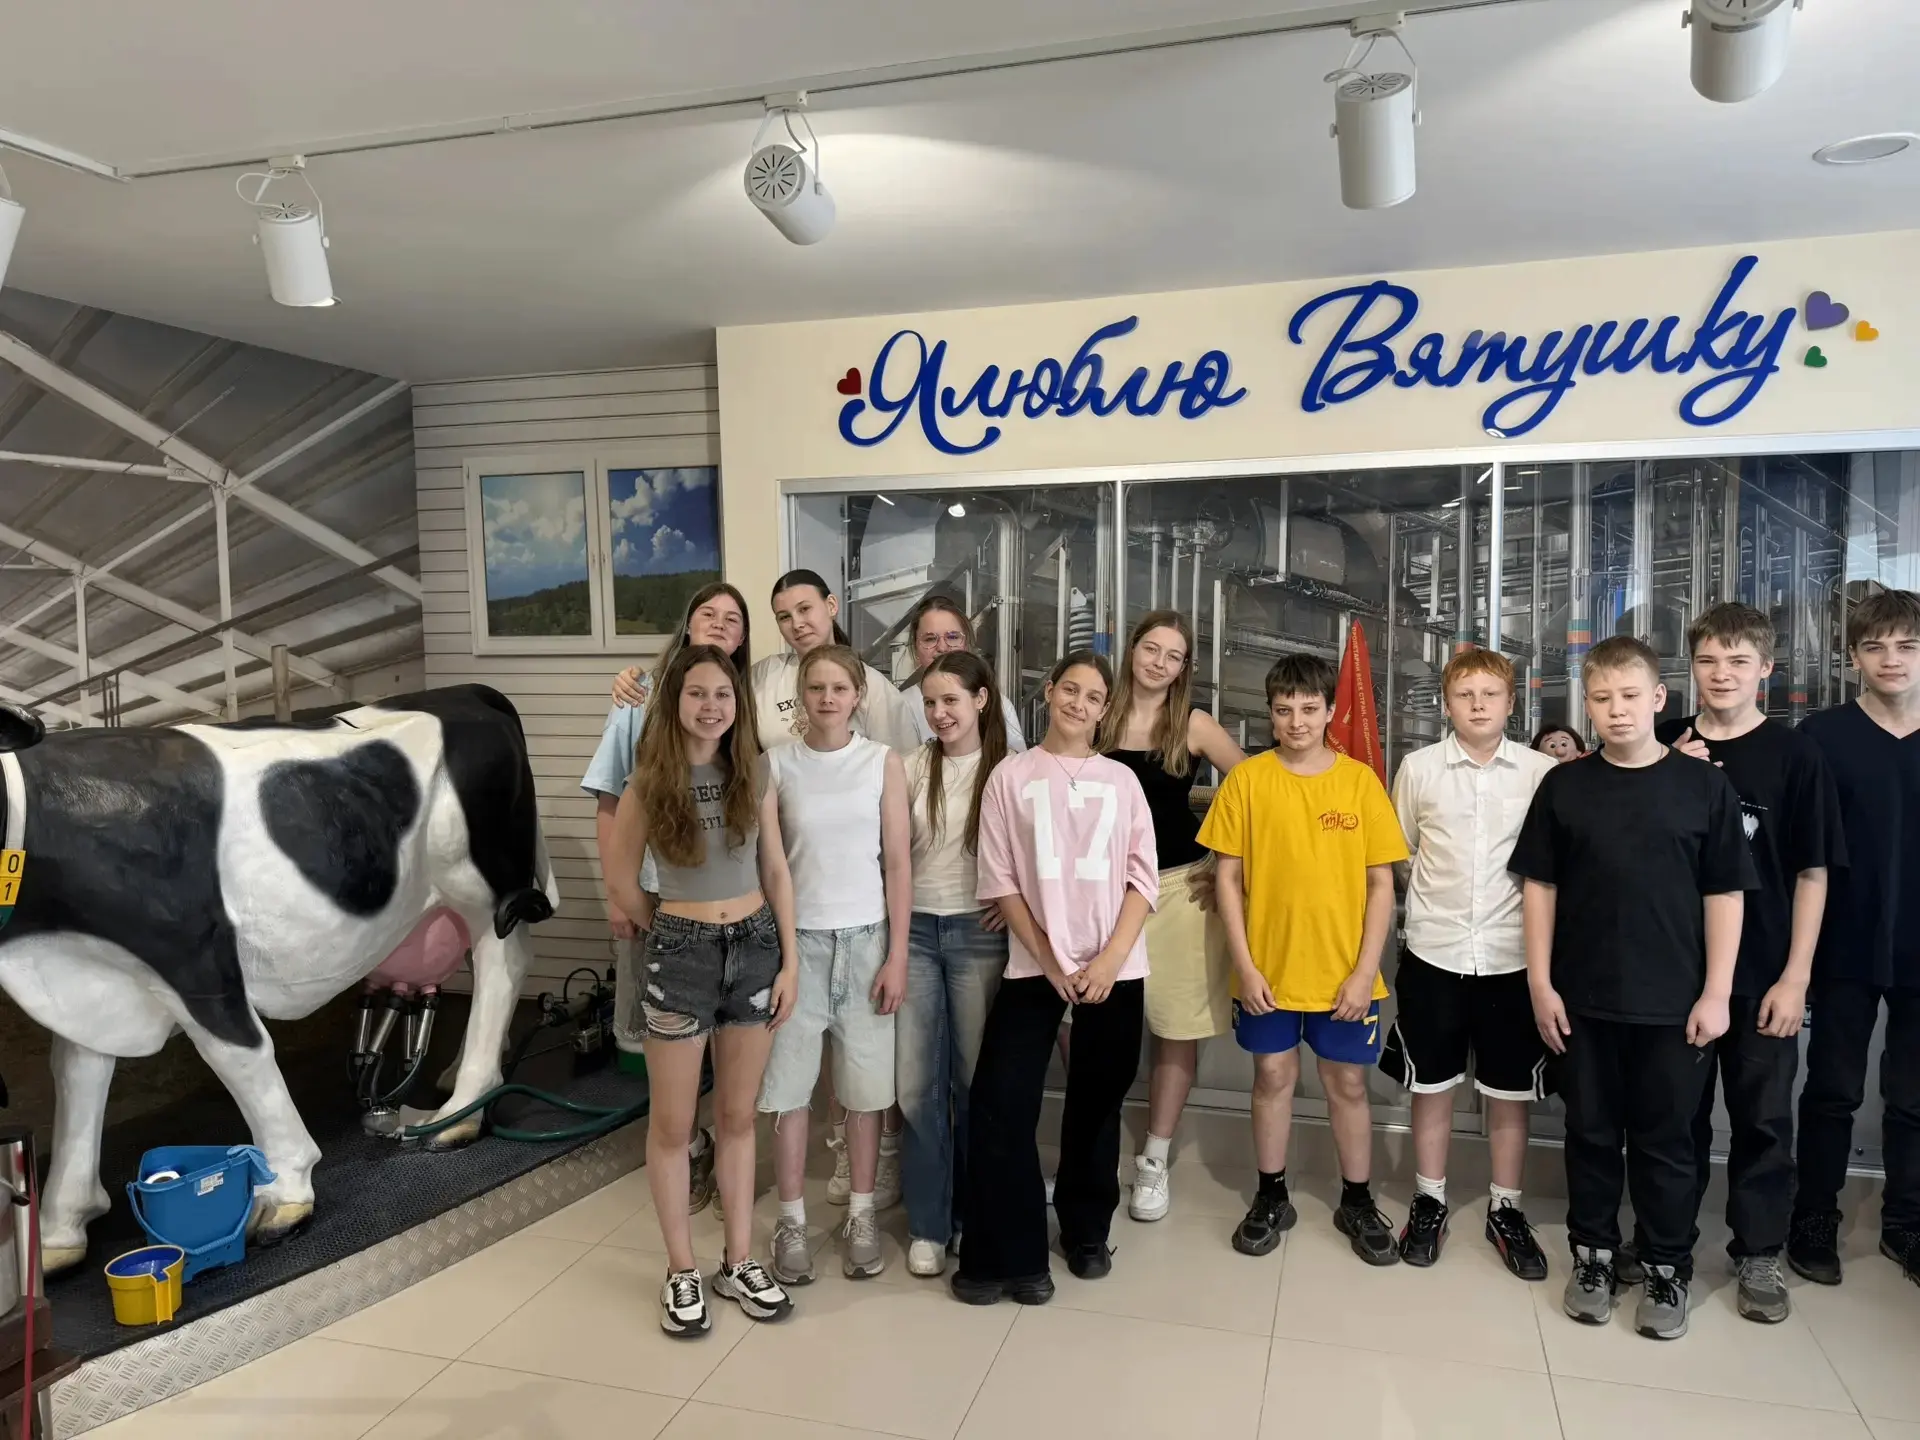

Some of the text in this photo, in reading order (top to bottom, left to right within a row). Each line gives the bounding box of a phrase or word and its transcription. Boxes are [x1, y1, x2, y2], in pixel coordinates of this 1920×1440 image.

[1287, 255, 1797, 439] Вятушку
[1021, 778, 1118, 880] 17
[8, 853, 20, 874] 0
[5, 881, 12, 902] 1
[1363, 1014, 1379, 1045] 7
